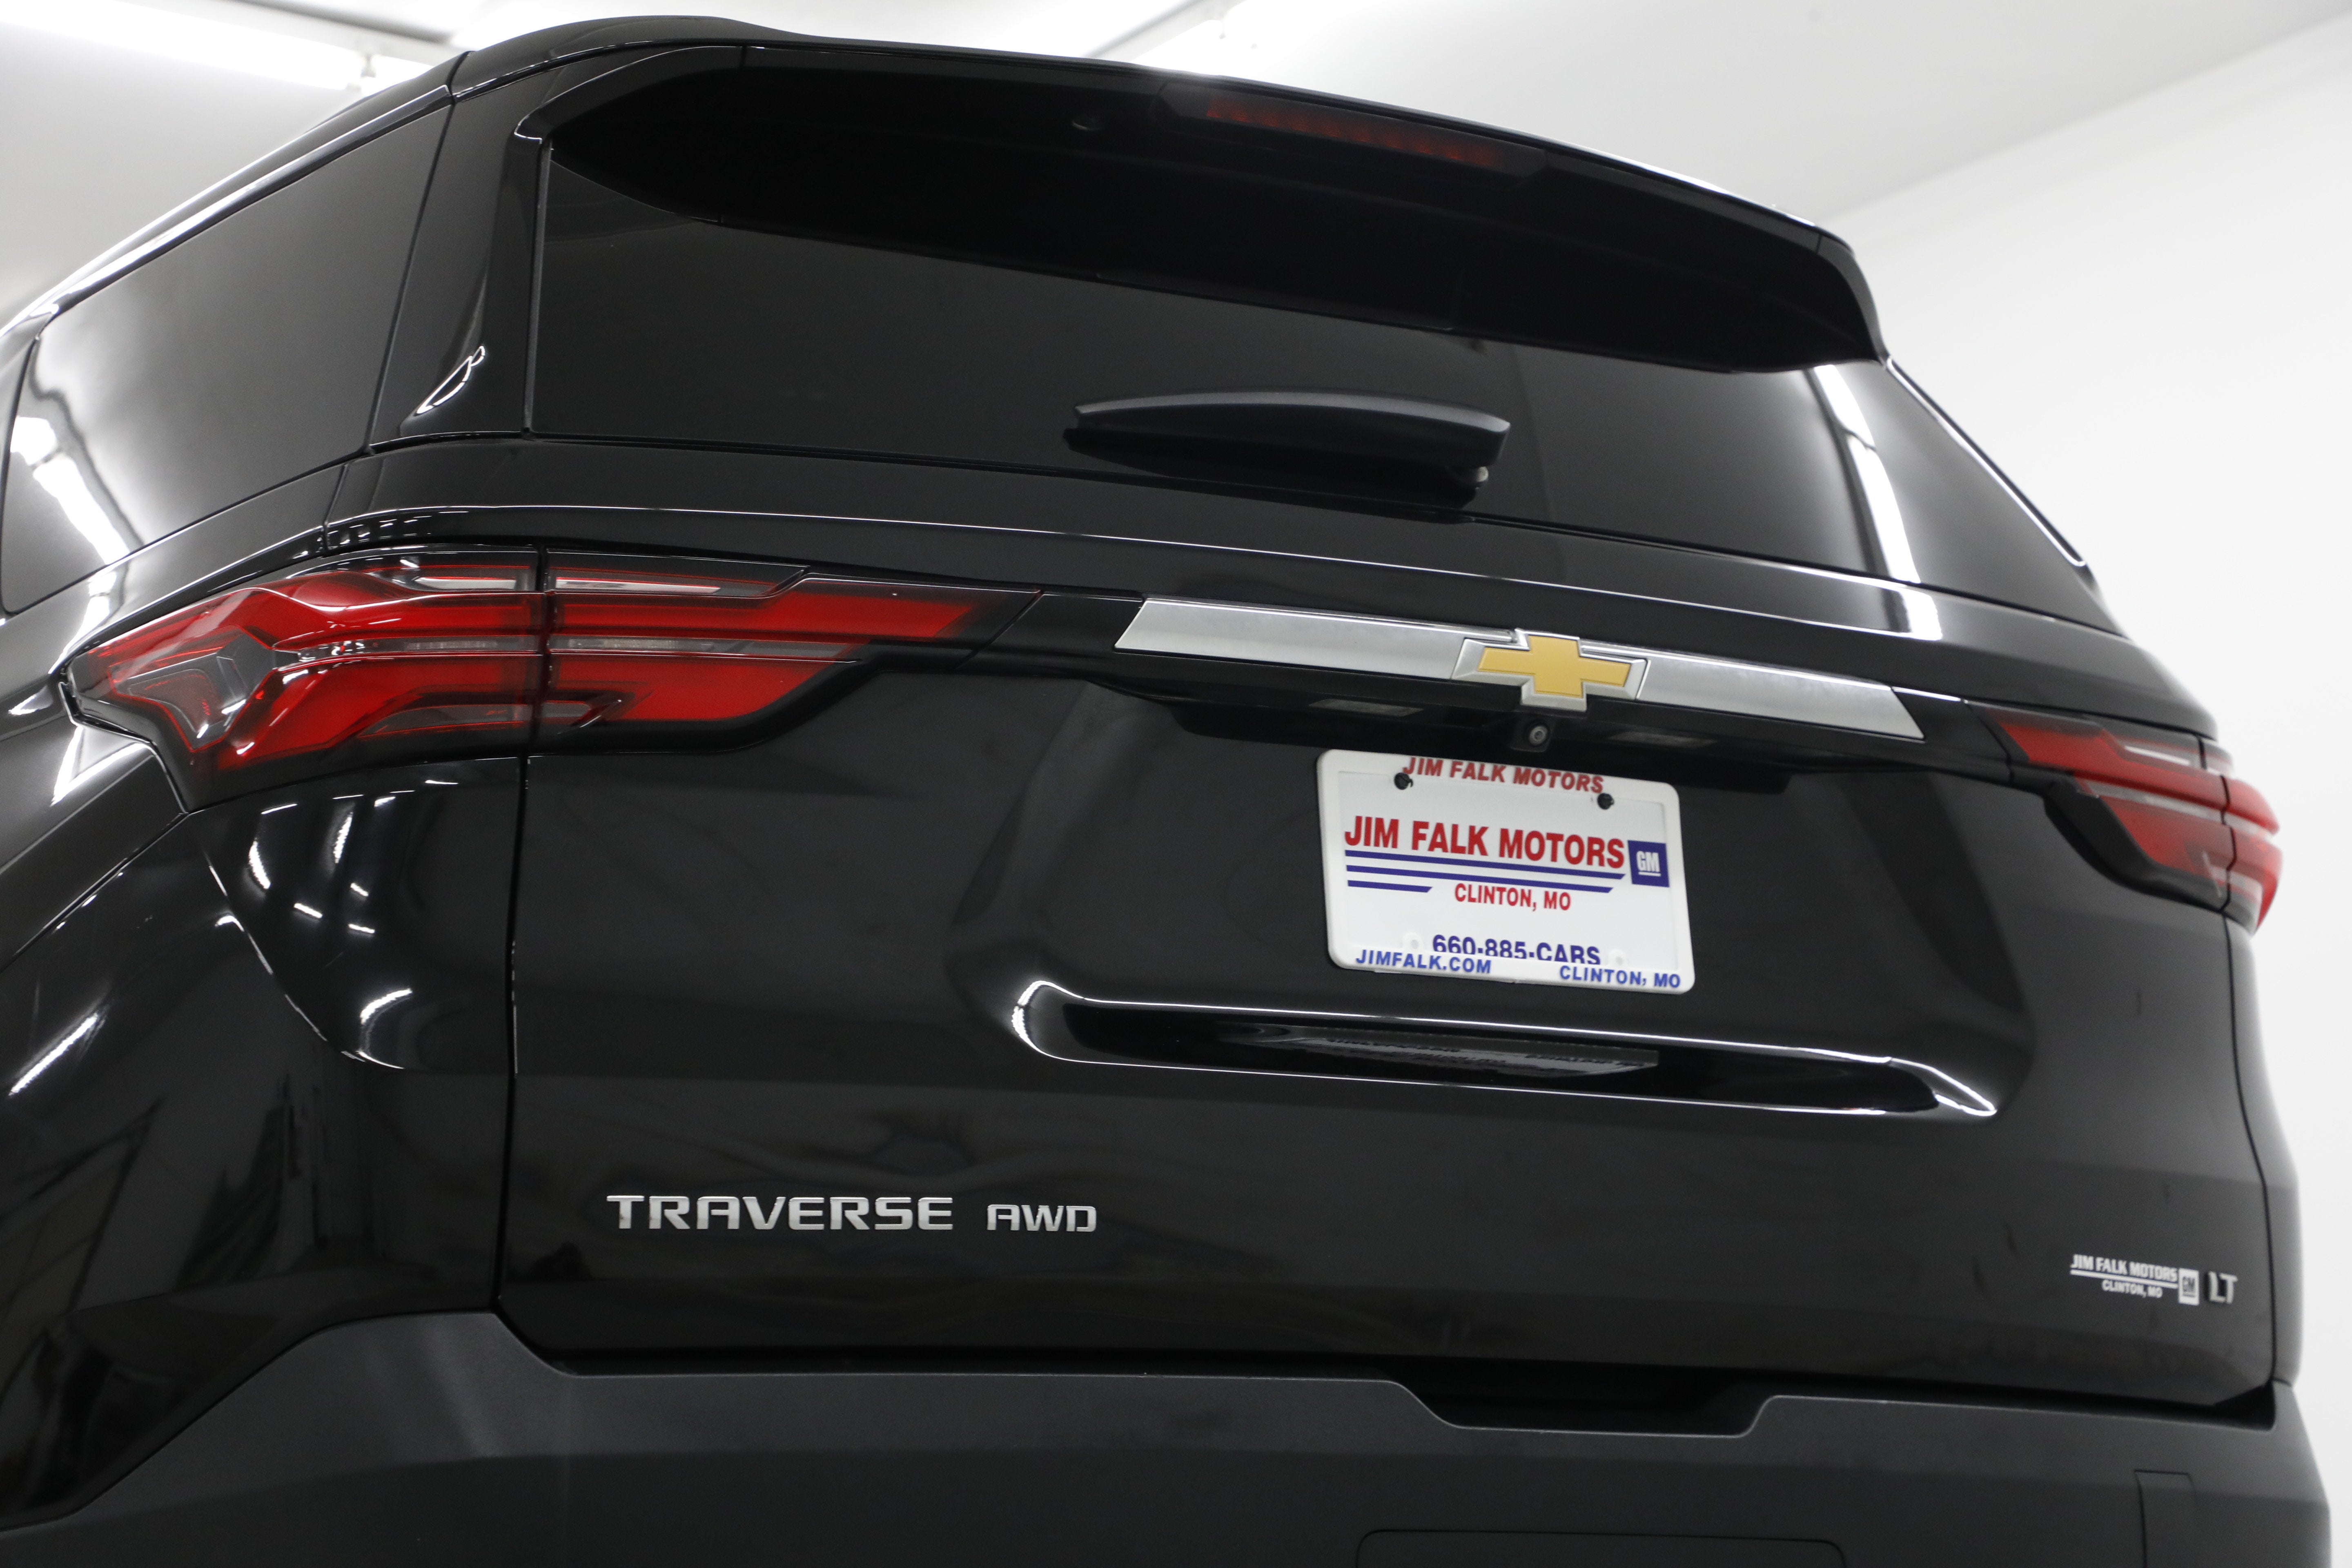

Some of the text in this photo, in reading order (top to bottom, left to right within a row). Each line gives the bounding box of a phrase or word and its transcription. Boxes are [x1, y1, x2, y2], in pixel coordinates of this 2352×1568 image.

[1402, 757, 1604, 793] JIM FALK MOTORS
[1345, 815, 1624, 869] JIM FALK MOTORS
[1636, 851, 1660, 874] GM
[1454, 883, 1571, 911] CLINTON, MO
[1356, 949, 1491, 974] JIMFALK.COM
[1559, 965, 1681, 988] CLINTON, MO
[606, 1195, 1097, 1232] TRAVERSE AWD
[2070, 1254, 2178, 1282] JIM FALK MOTORS
[2101, 1279, 2163, 1298] CLINTON, MO
[2181, 1276, 2196, 1293] GM
[2208, 1271, 2238, 1304] LT
